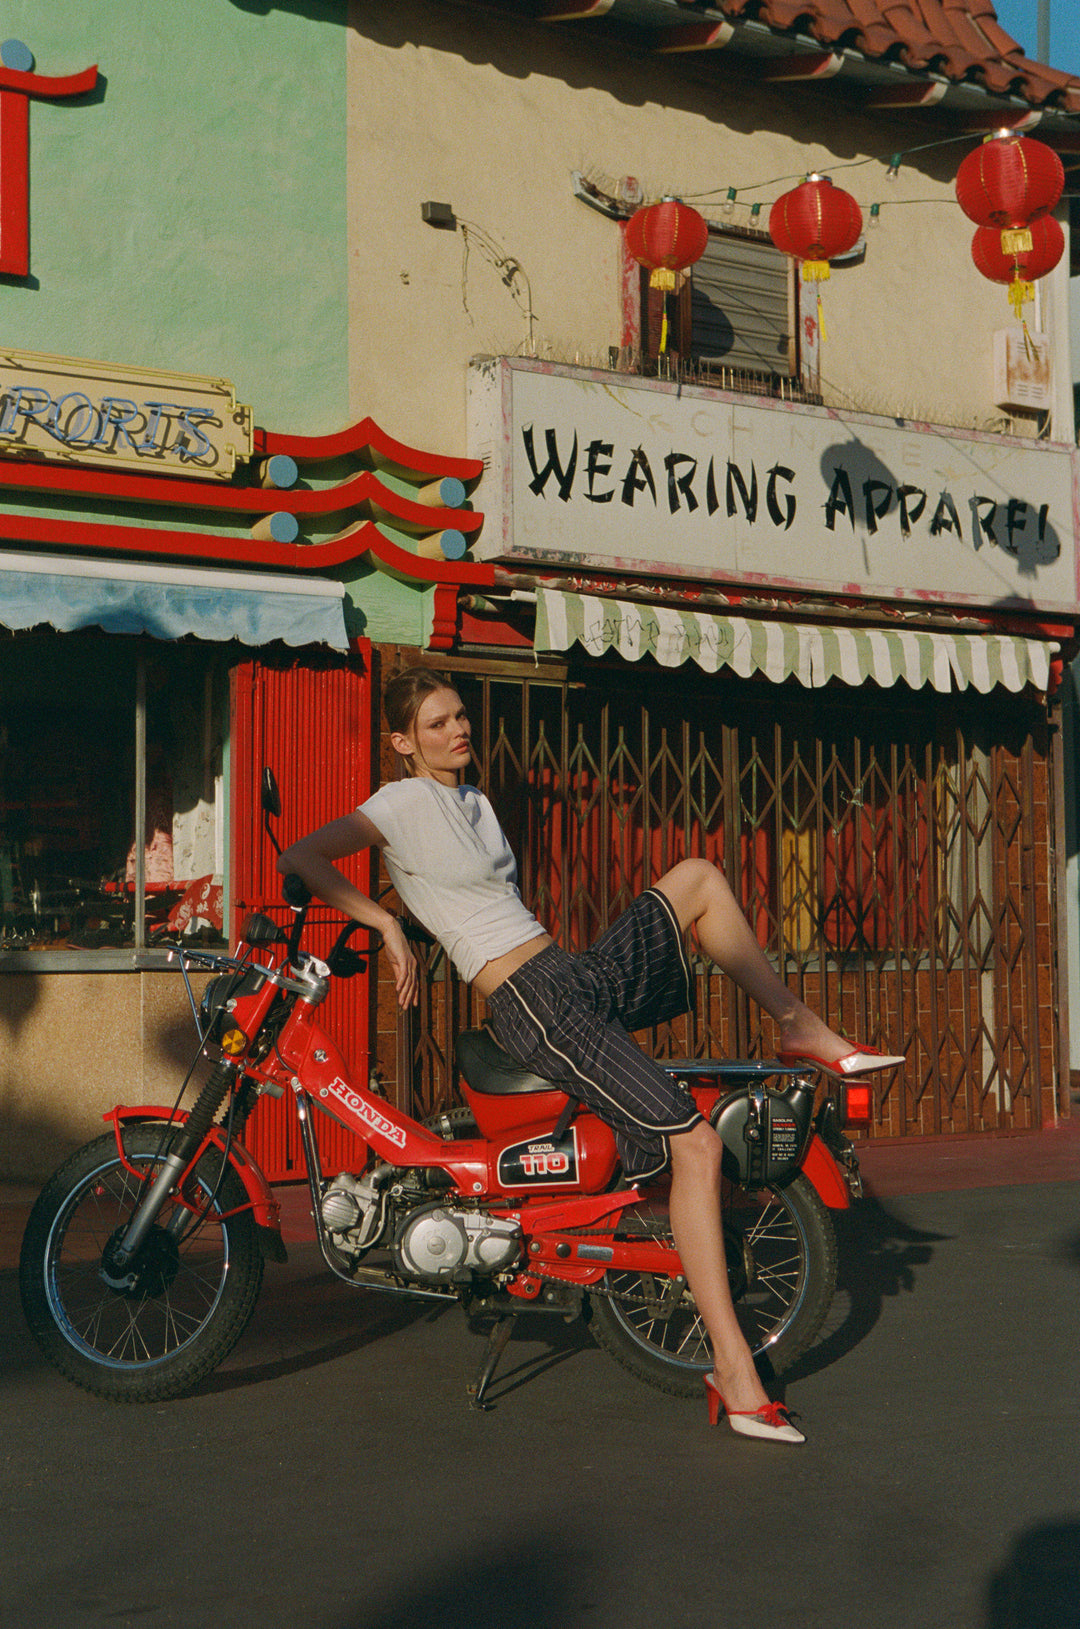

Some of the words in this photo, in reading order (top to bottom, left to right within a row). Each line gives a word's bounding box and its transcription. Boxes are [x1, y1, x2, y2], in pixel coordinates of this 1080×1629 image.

[521, 423, 797, 532] WEARING
[328, 1076, 406, 1149] HONDA
[520, 1152, 569, 1175] 110
[528, 1143, 555, 1154] TRAIL
